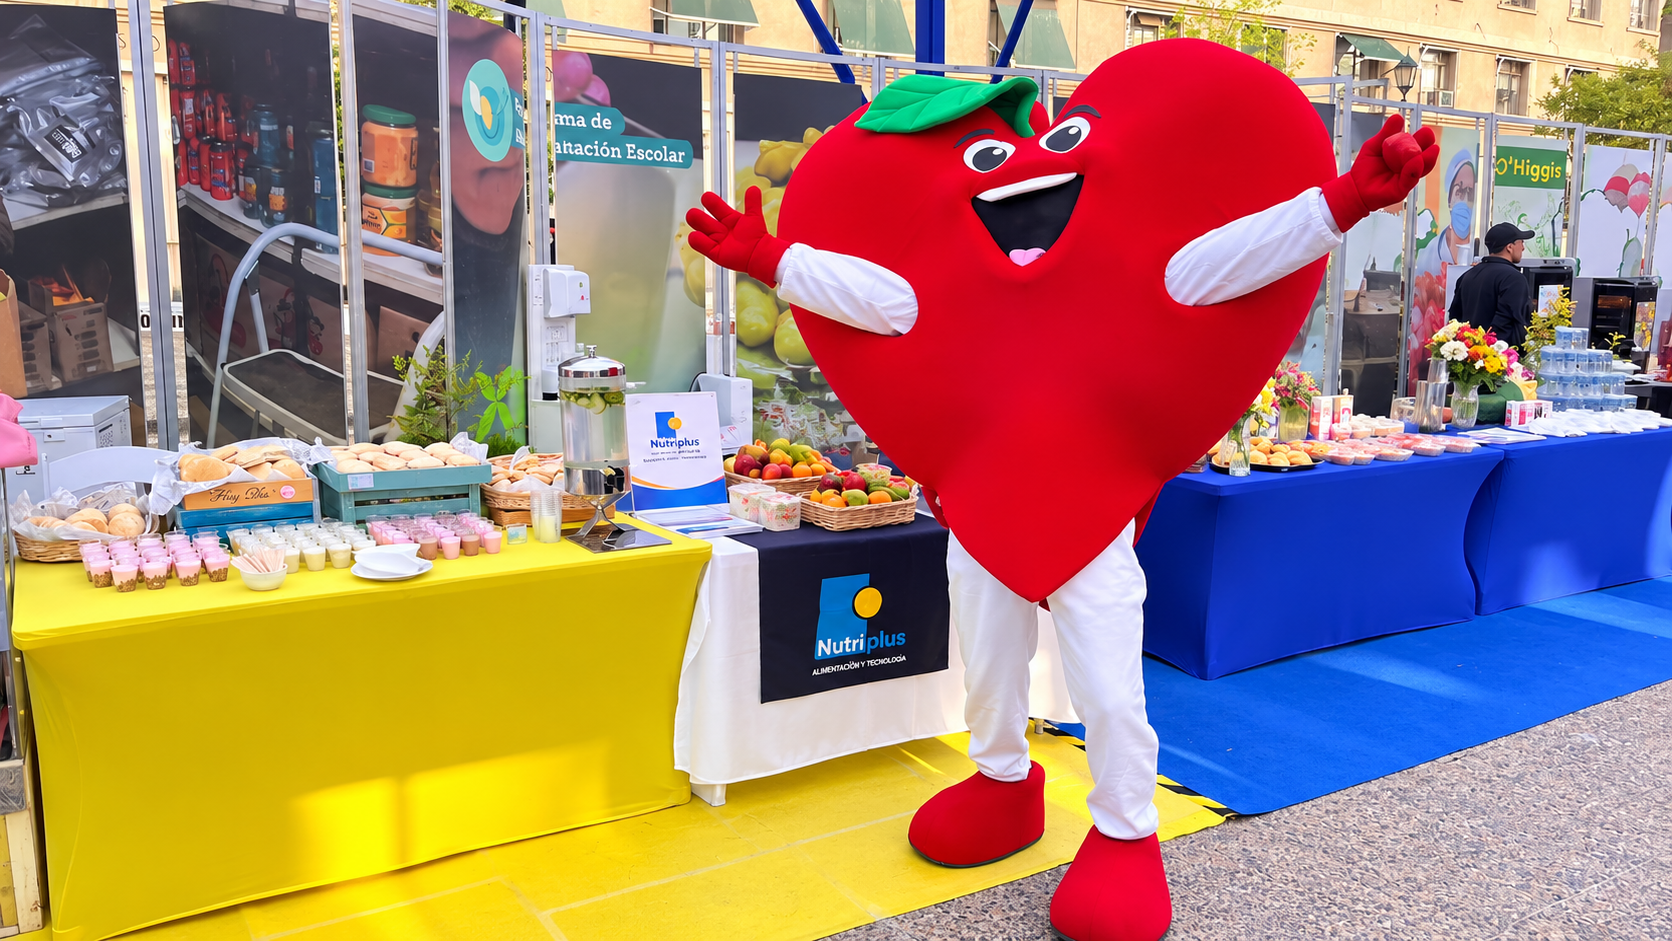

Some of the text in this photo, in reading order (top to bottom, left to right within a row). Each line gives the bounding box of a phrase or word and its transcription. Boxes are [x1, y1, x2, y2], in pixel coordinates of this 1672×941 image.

[590, 112, 612, 130] de
[625, 143, 685, 163] Escolar
[650, 437, 700, 449] Nutriplus
[817, 630, 906, 657] Nutriplus
[860, 660, 866, 668] Y
